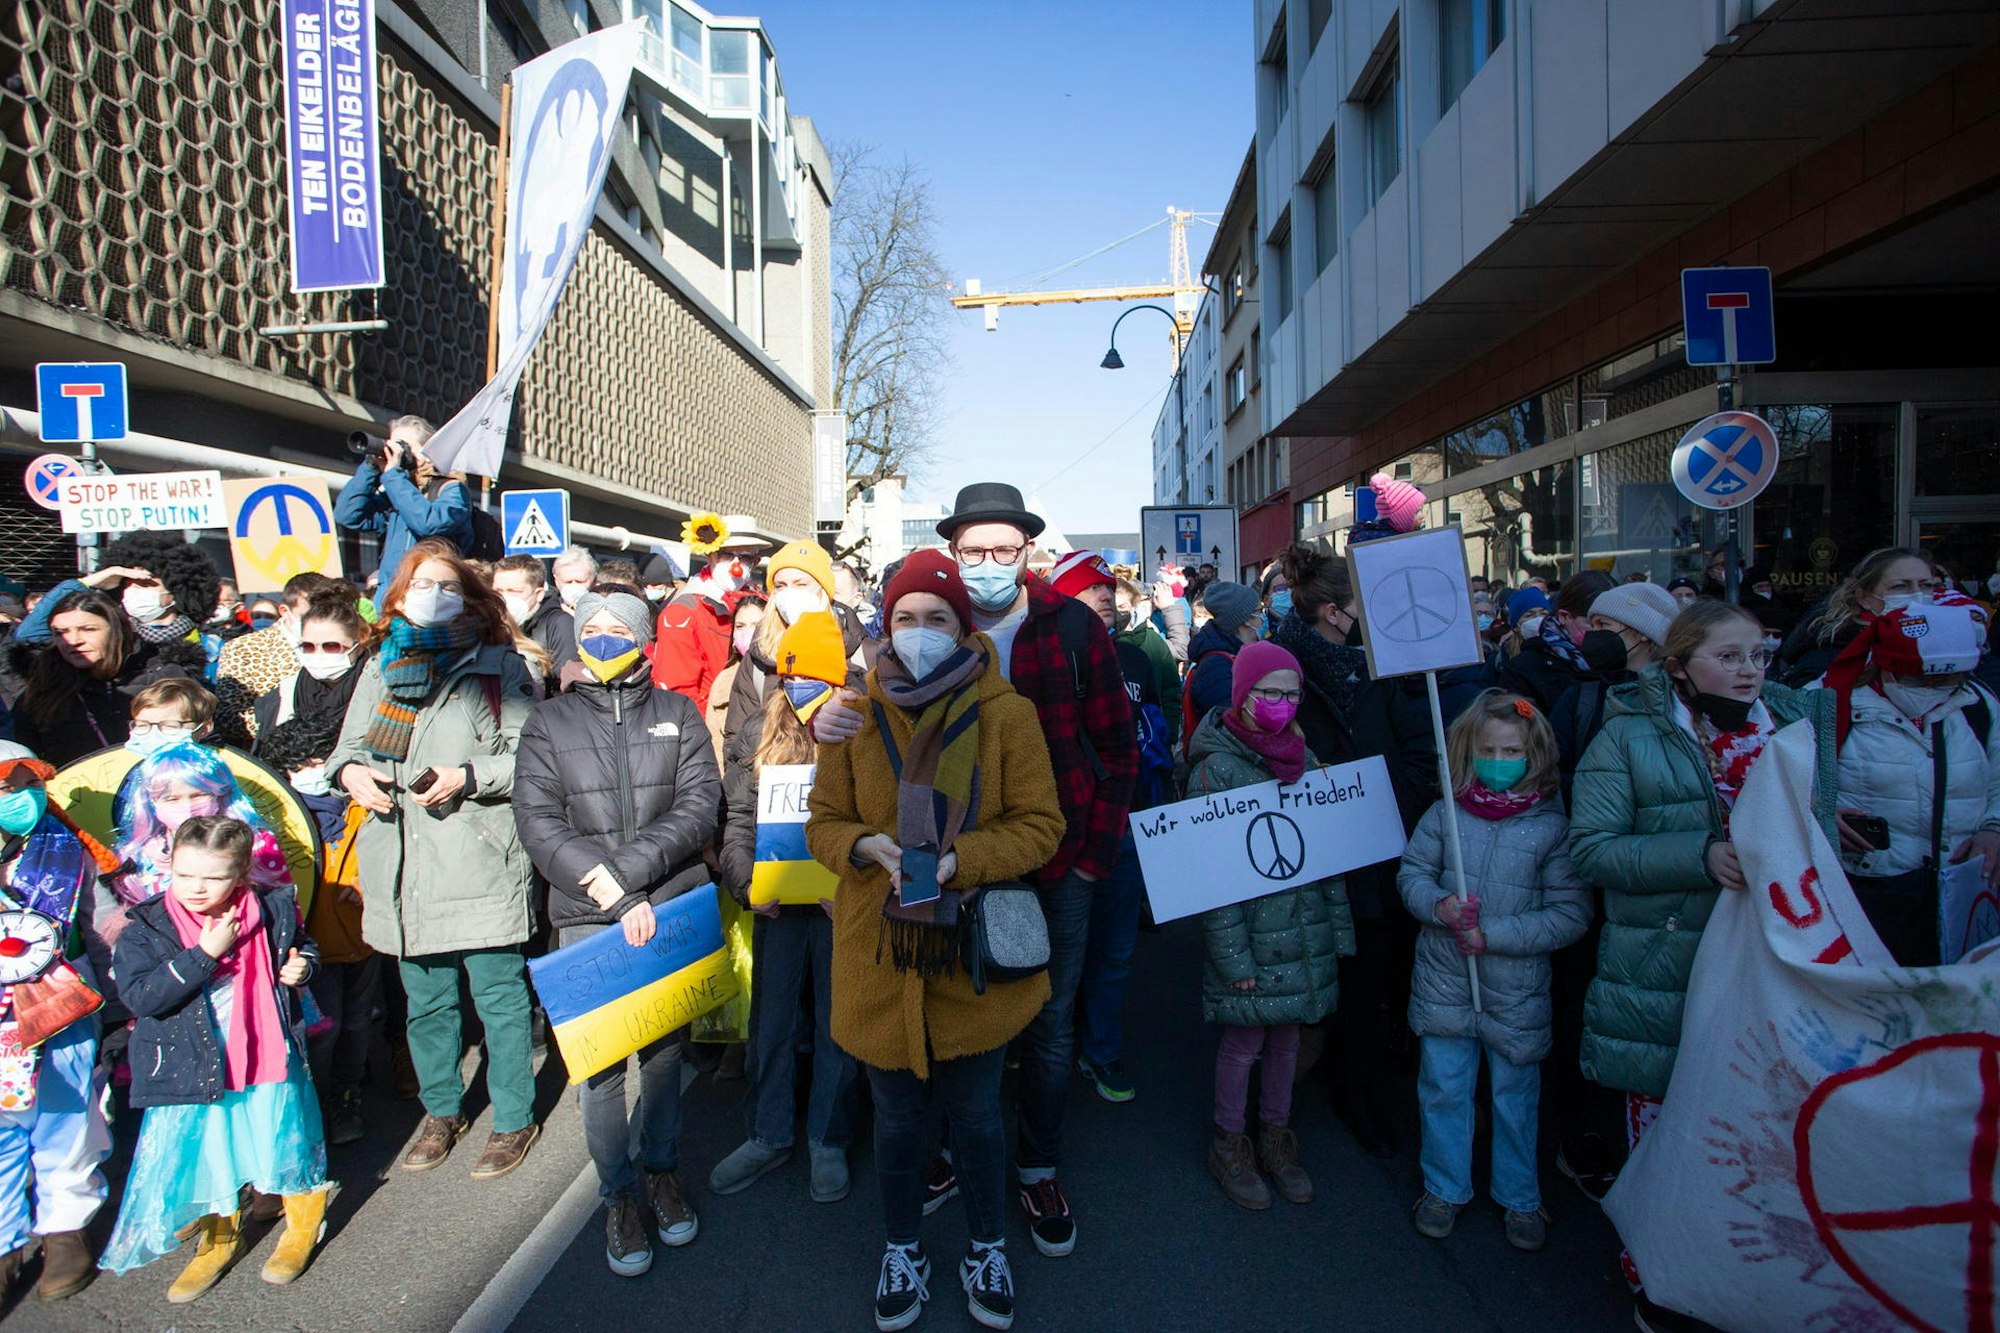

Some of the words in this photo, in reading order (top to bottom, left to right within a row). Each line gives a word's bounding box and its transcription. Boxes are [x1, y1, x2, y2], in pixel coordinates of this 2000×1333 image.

[295, 13, 326, 152] EIKELDER
[300, 160, 328, 215] TEN
[68, 483, 118, 505] STOP
[127, 481, 158, 501] THE
[167, 478, 212, 498] WAR!
[141, 505, 209, 526] PUTIN!
[1769, 572, 1840, 586] PAUSEN
[768, 782, 813, 814] FRE
[1140, 812, 1179, 838] Wir
[1191, 797, 1260, 825] wollen
[1277, 772, 1365, 809] Frieden!
[651, 913, 699, 958] WAR
[623, 975, 725, 1043] UKRAINE
